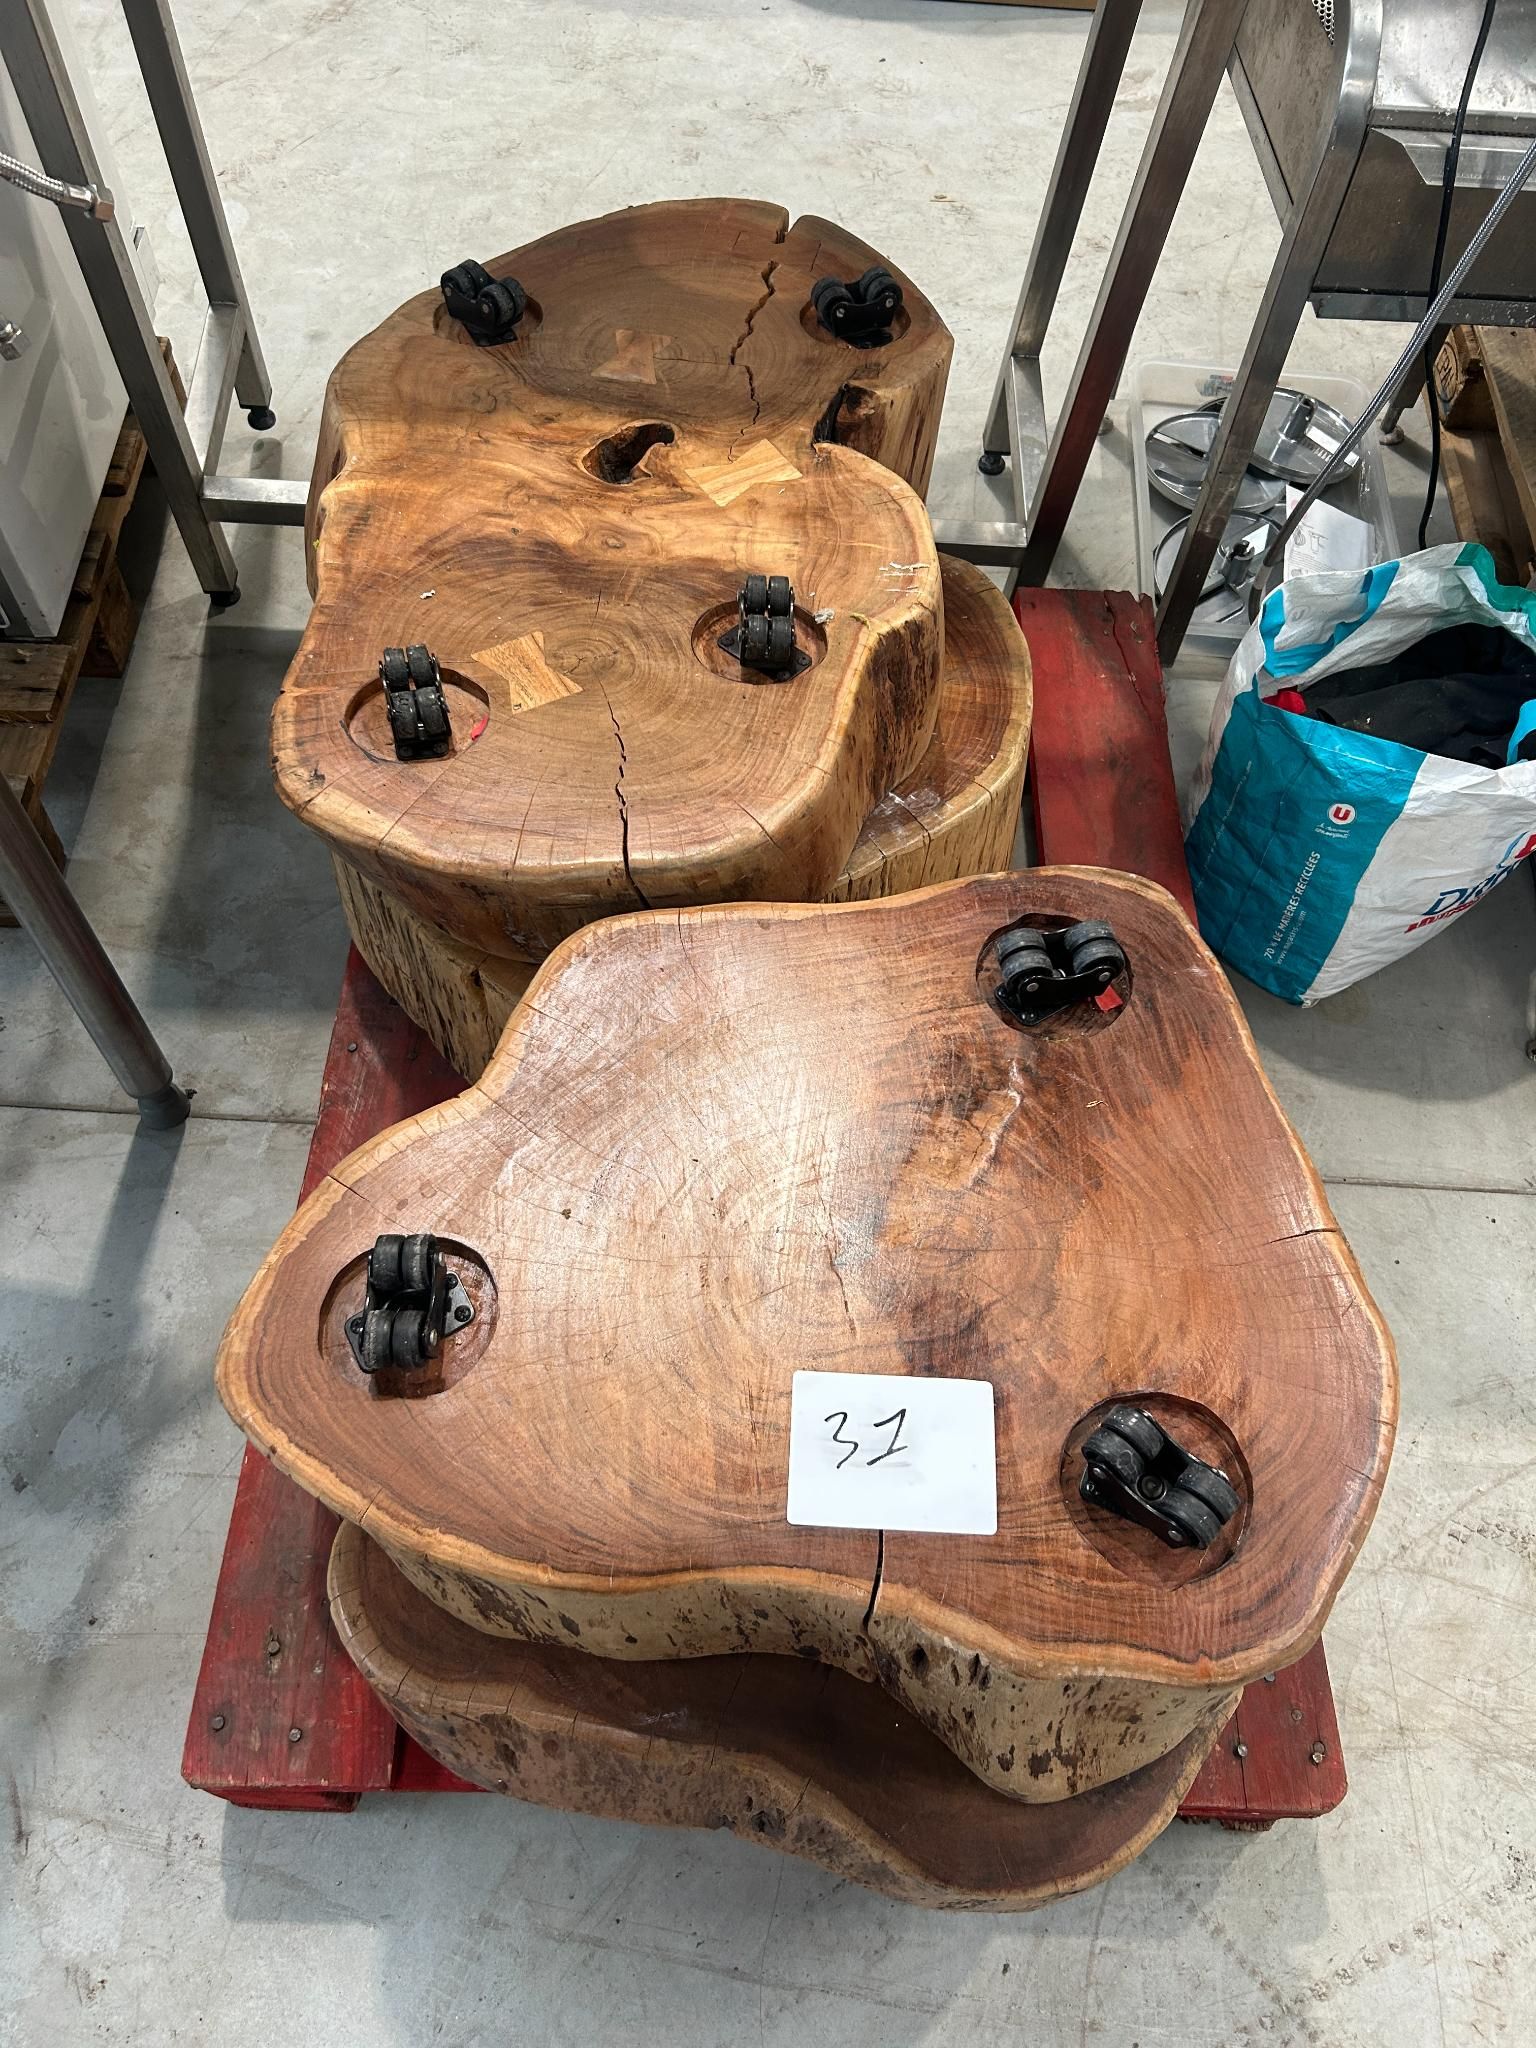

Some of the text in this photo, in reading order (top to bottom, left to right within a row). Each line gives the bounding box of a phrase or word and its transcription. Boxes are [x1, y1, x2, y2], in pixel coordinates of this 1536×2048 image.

[1333, 805, 1351, 821] U
[1264, 947, 1275, 960] 70
[1295, 851, 1320, 895] RECYCLÉES
[824, 1408, 908, 1469] 31
